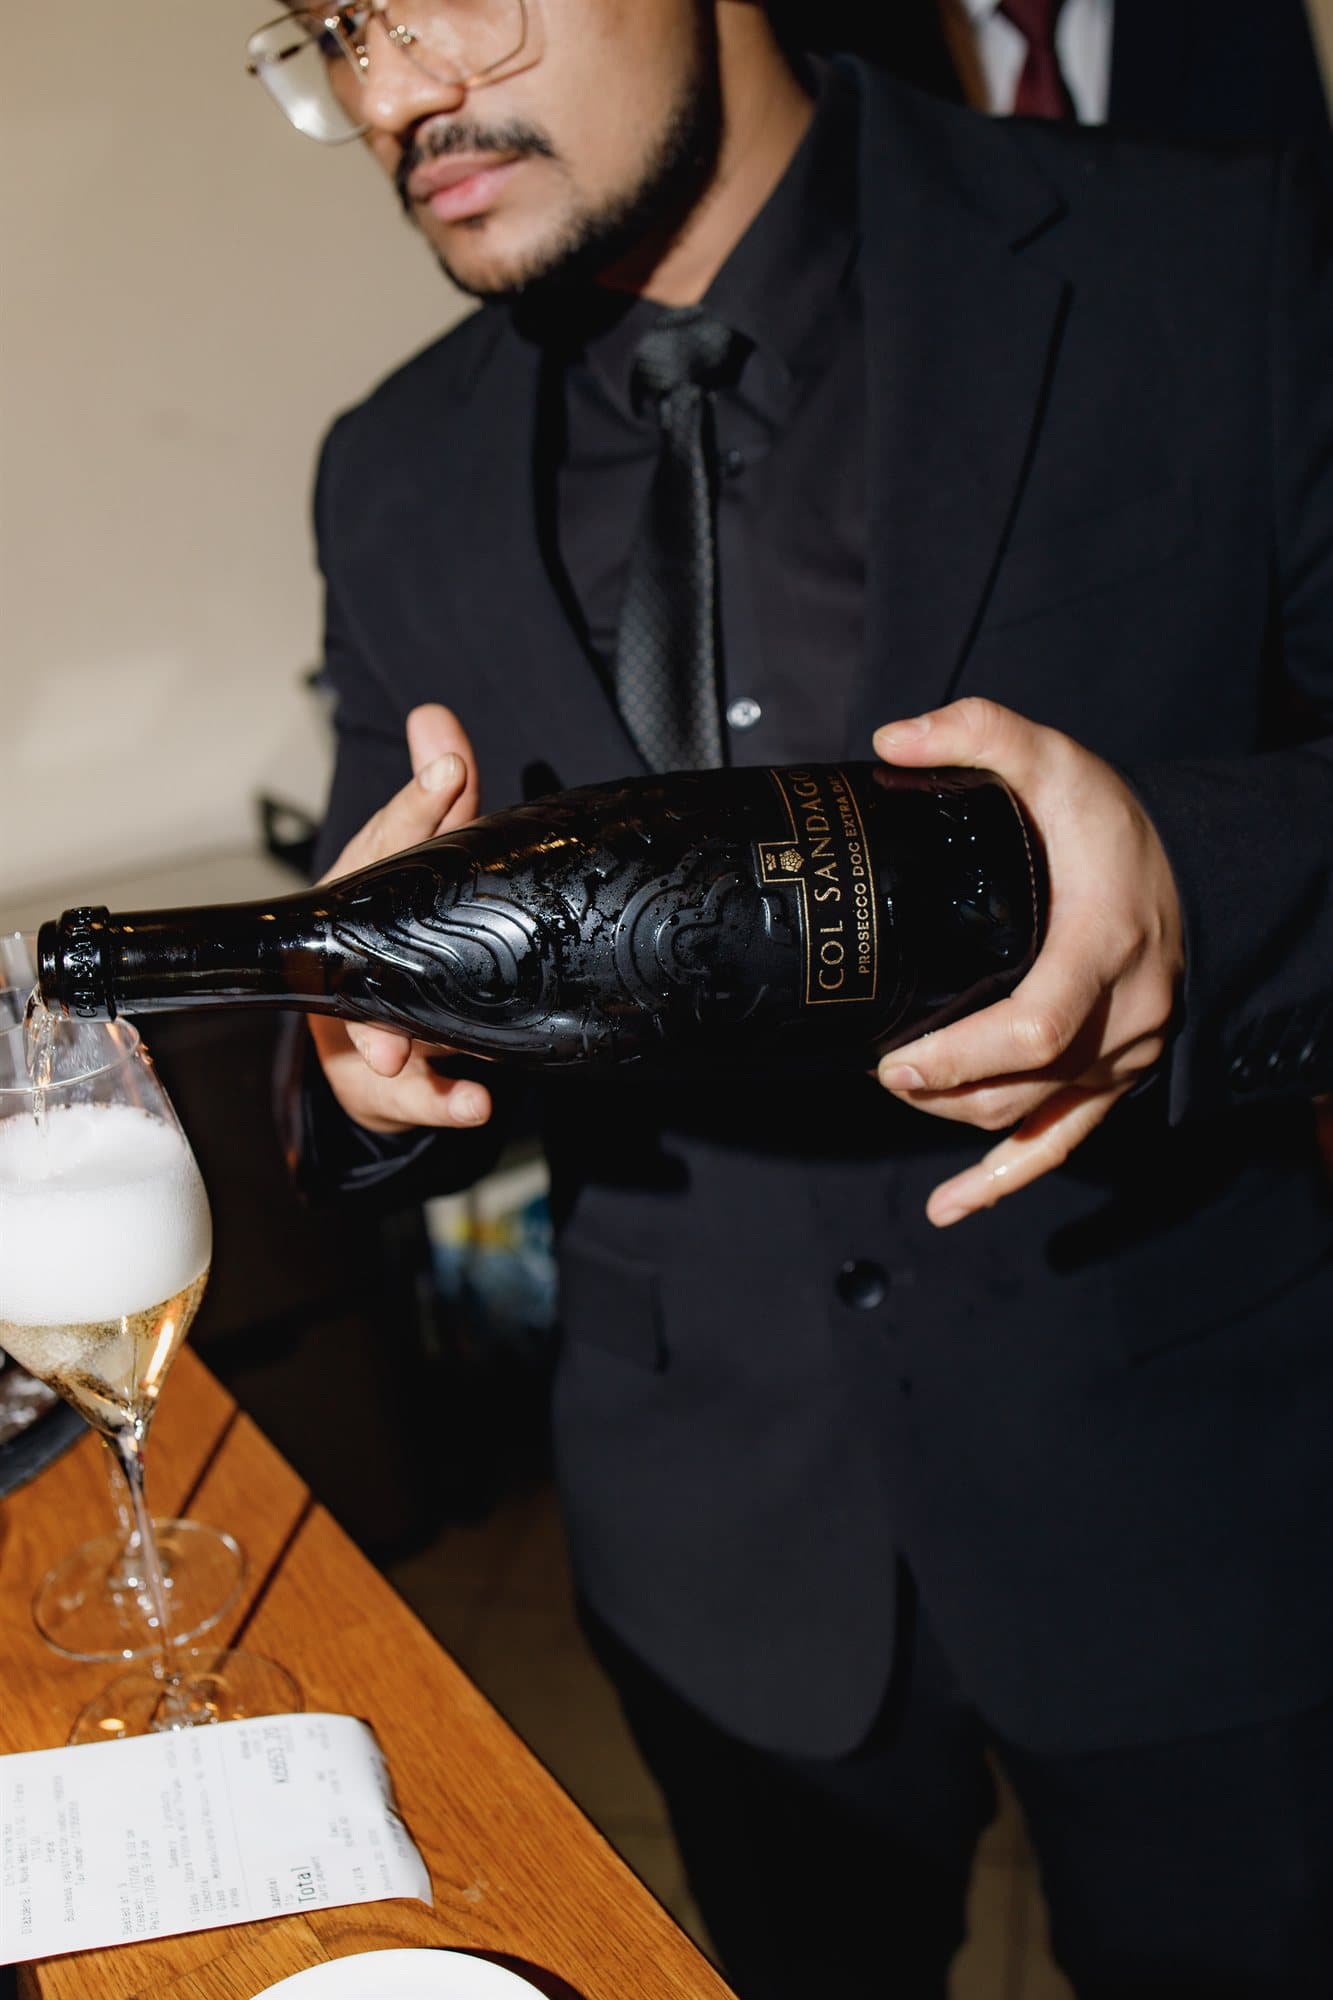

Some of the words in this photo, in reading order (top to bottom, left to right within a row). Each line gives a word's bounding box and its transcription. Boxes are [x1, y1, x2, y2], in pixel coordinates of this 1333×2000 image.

[791, 771, 841, 902] SANDAGO
[836, 794, 857, 838] EXTRA
[848, 841, 865, 877] DOC
[854, 882, 871, 974] PROSECCO
[818, 920, 845, 990] COL
[64, 1887, 75, 1922] Business
[292, 1867, 316, 1903] Total
